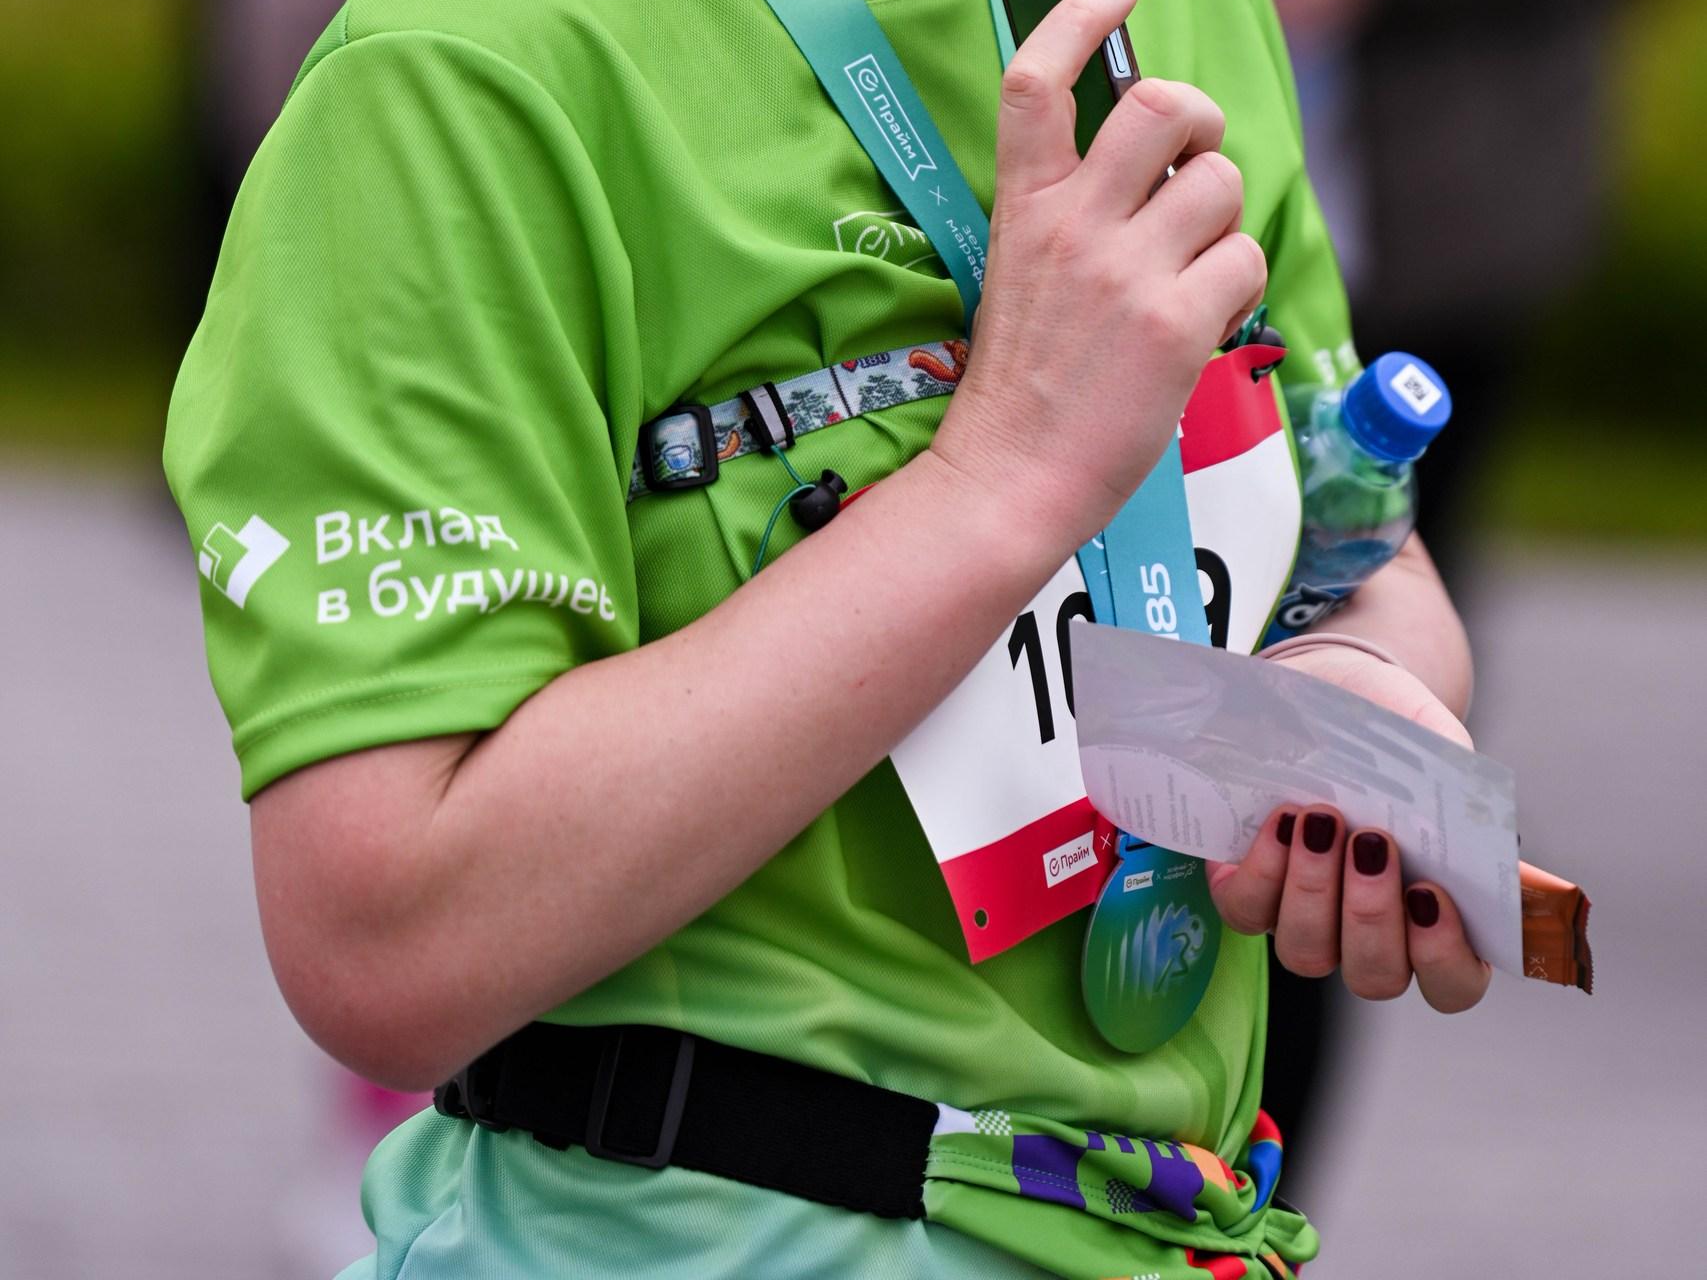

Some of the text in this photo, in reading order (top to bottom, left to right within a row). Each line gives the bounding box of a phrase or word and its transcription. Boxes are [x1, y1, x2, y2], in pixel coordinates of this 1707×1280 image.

[872, 93, 918, 160] Прайм
[315, 507, 520, 565] Вклад
[315, 587, 350, 625] в
[1060, 845, 1090, 870] Прайм
